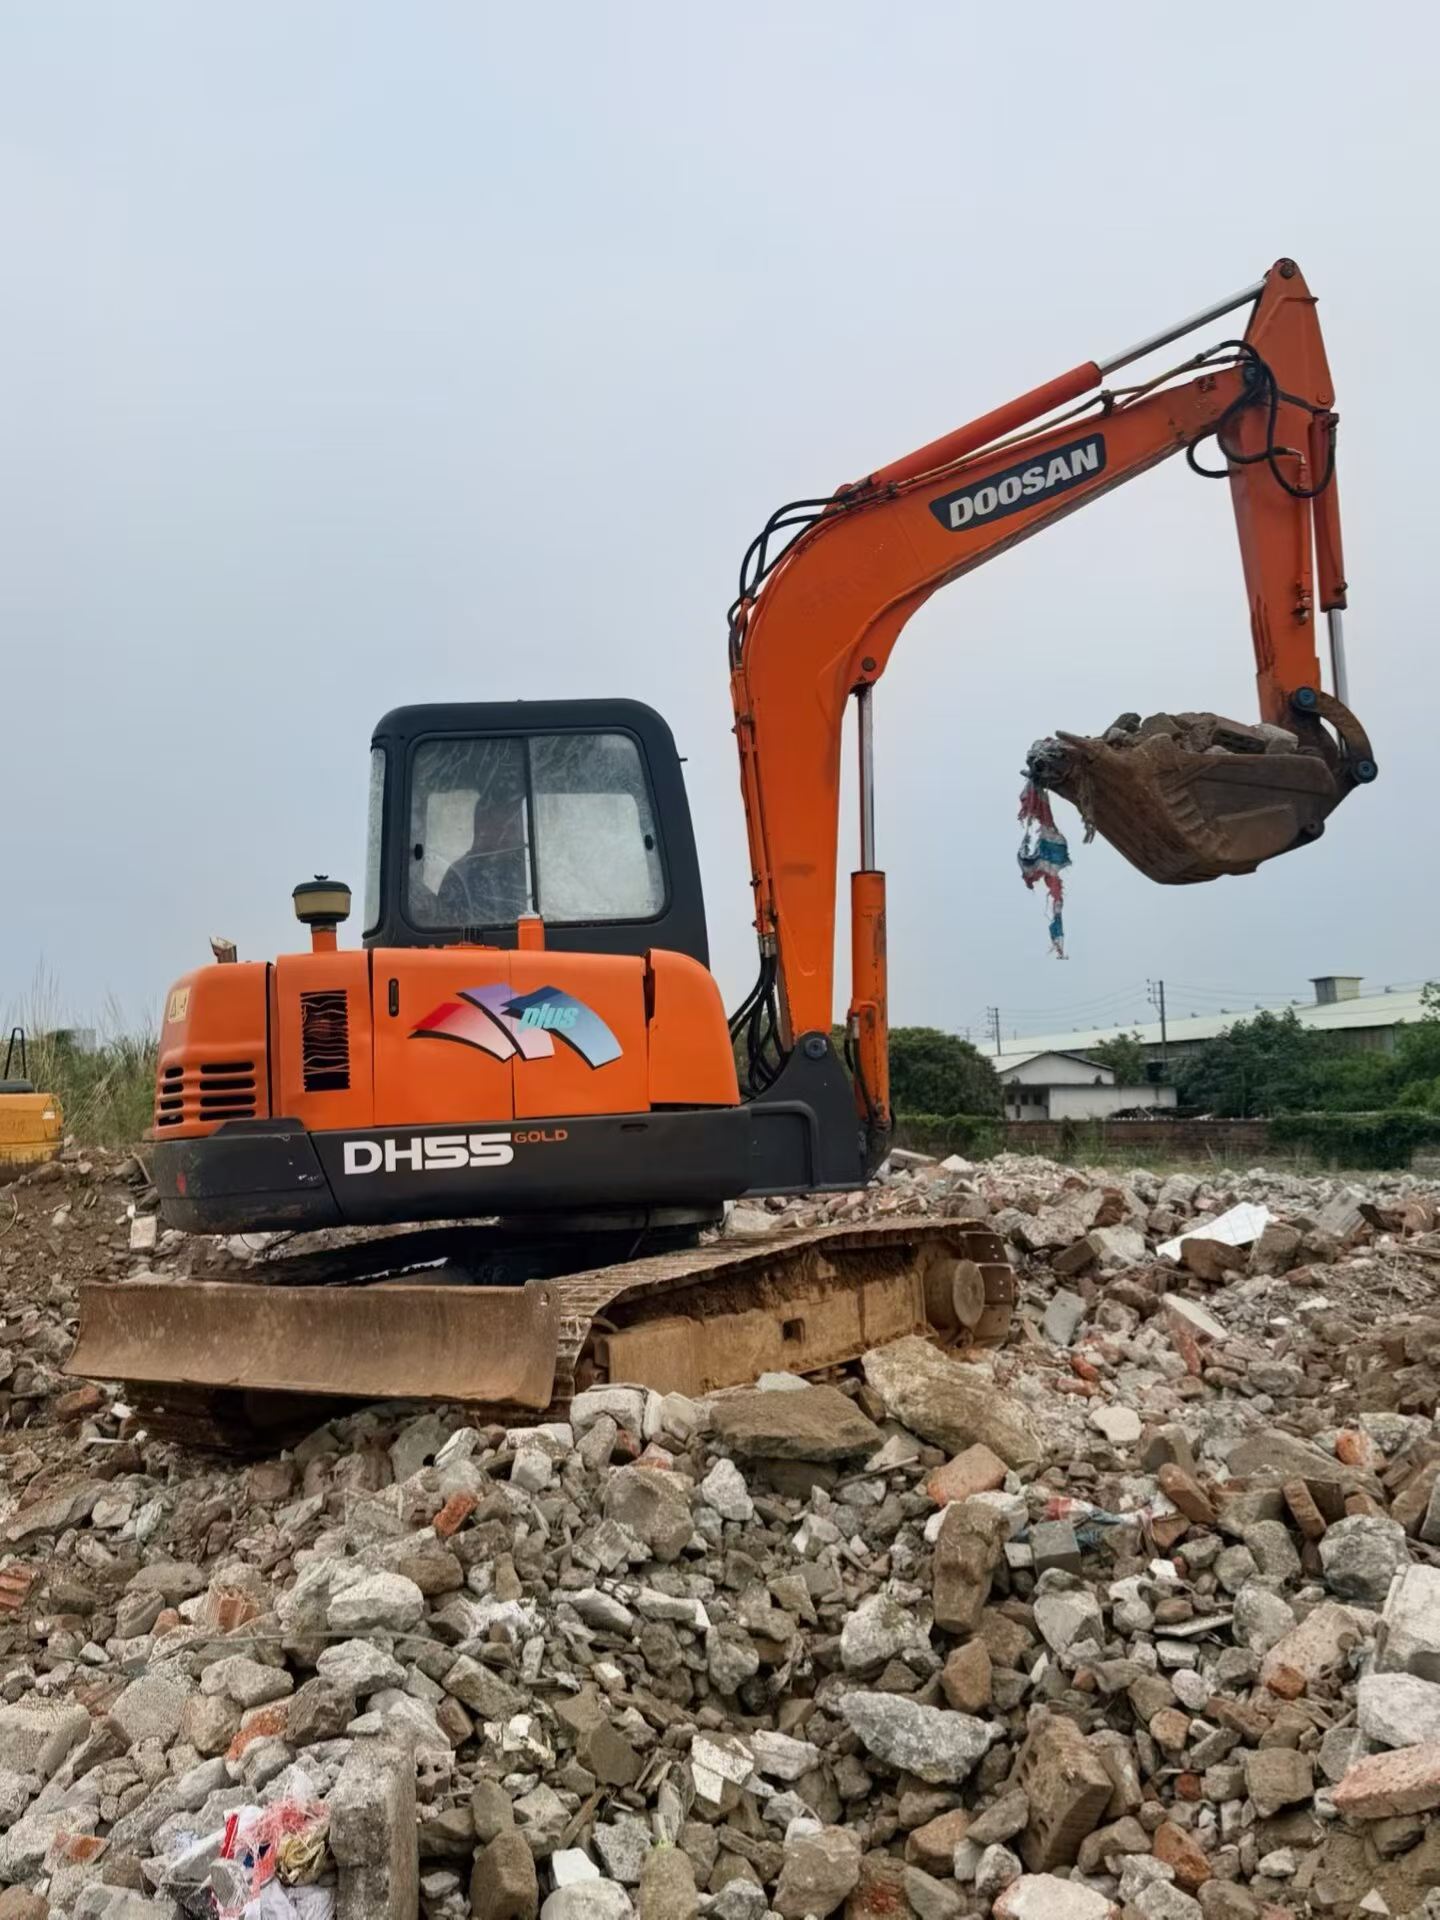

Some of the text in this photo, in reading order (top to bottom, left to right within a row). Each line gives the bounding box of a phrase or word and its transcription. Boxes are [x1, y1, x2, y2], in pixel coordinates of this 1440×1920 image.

[949, 443, 1099, 528] DOOSAN
[517, 1003, 579, 1034] plus
[343, 1129, 568, 1175] DH55 GOLD
